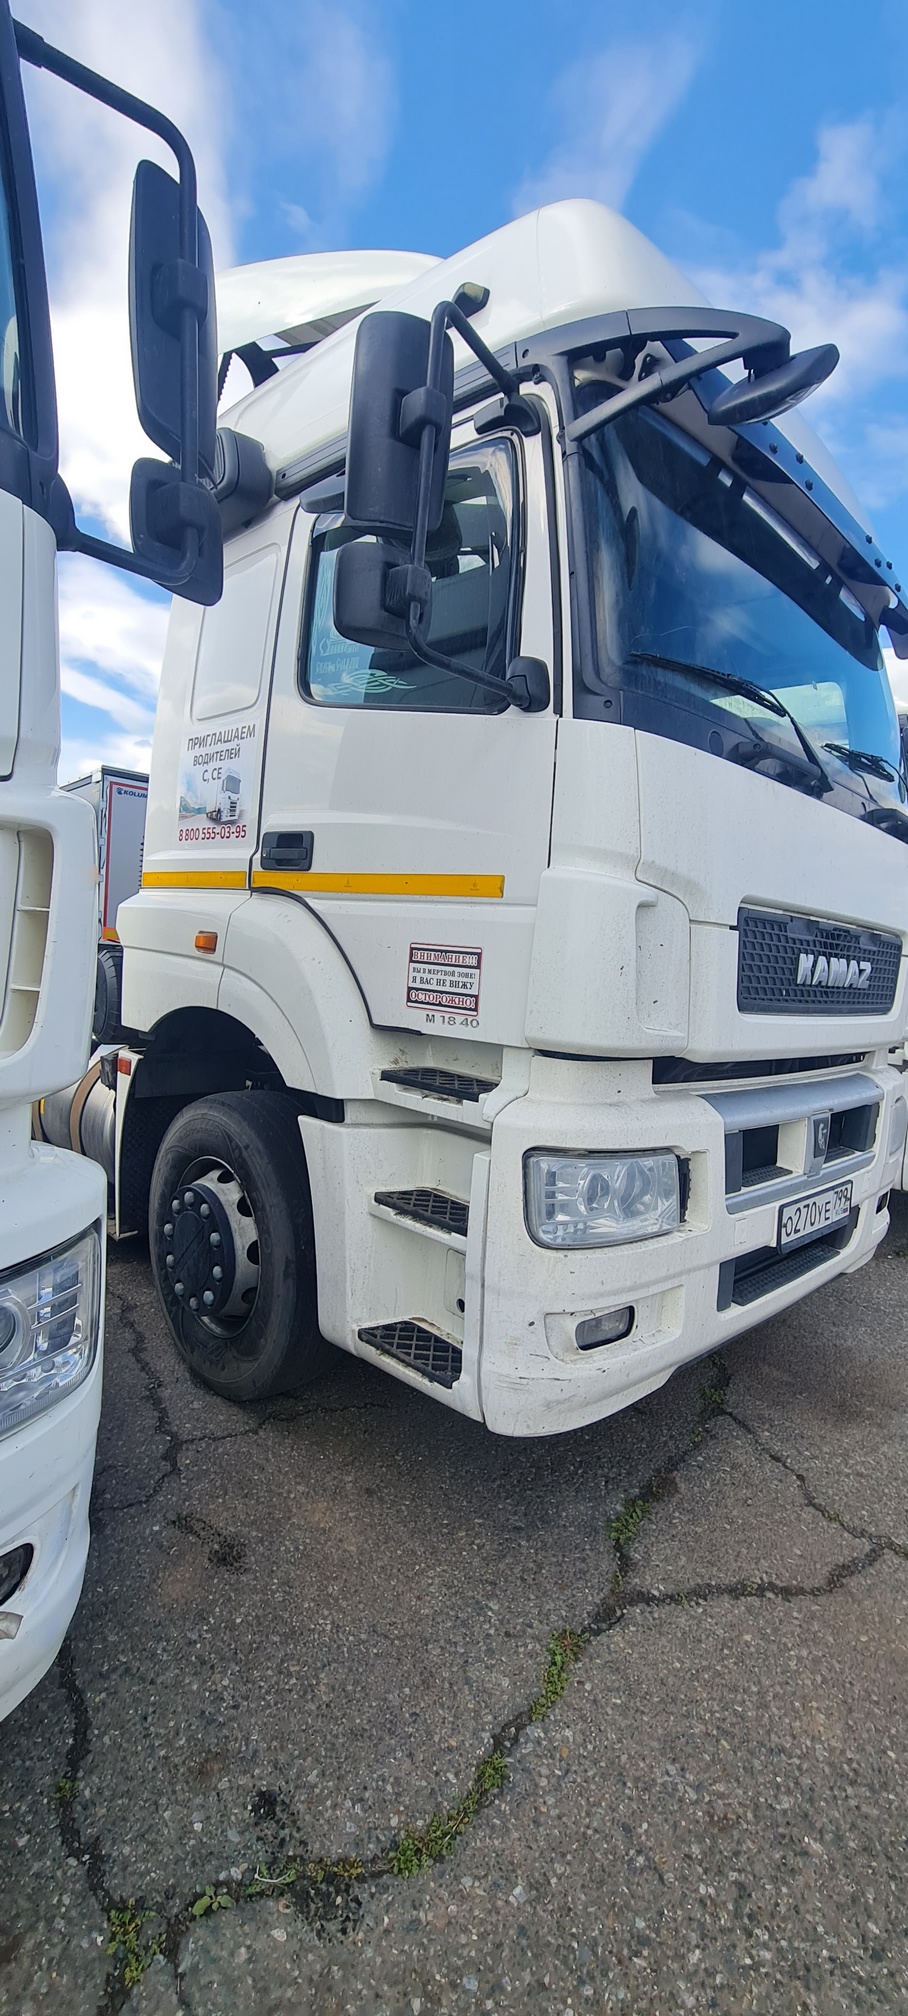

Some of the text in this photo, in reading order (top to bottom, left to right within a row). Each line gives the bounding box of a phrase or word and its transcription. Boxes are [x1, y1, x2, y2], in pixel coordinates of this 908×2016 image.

[187, 723, 256, 751] ПРИГЛАШАЕМ
[193, 743, 241, 767] ВОДИТЕЛЕЙ
[178, 824, 247, 842] 8 800 555-03-95
[412, 950, 478, 966] ВНИМАНИЕ!!!
[412, 966, 421, 974] ВЫ
[427, 967, 455, 978] МЕРТВОЙ
[456, 971, 476, 980] ЗОНЕ!
[796, 953, 872, 989] KAMAZ
[411, 976, 474, 990] Я ВАС НЕ ВИЖУ
[410, 990, 476, 1008] ОСТОРОЖНО!
